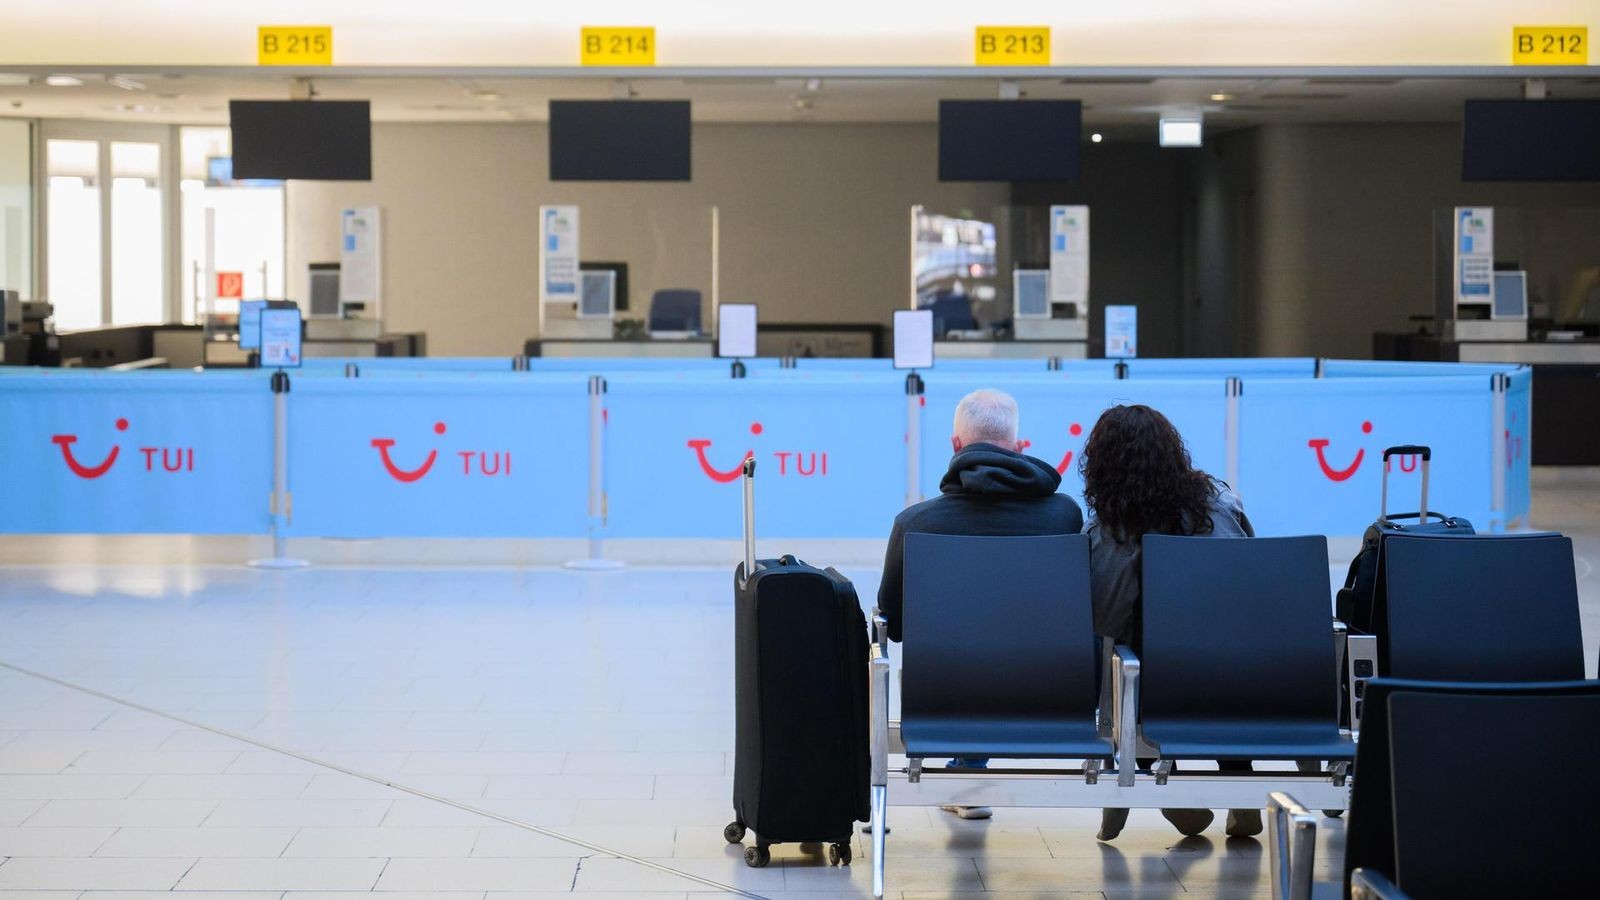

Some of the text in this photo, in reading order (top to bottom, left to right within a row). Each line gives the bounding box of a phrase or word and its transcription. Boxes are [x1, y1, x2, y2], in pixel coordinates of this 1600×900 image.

[263, 34, 326, 54] B 215
[586, 34, 648, 54] B 214
[981, 34, 1044, 54] B 213
[1518, 34, 1581, 53] B 212
[139, 447, 193, 473] TUI
[457, 451, 511, 476] TUI
[772, 451, 827, 476] TUI
